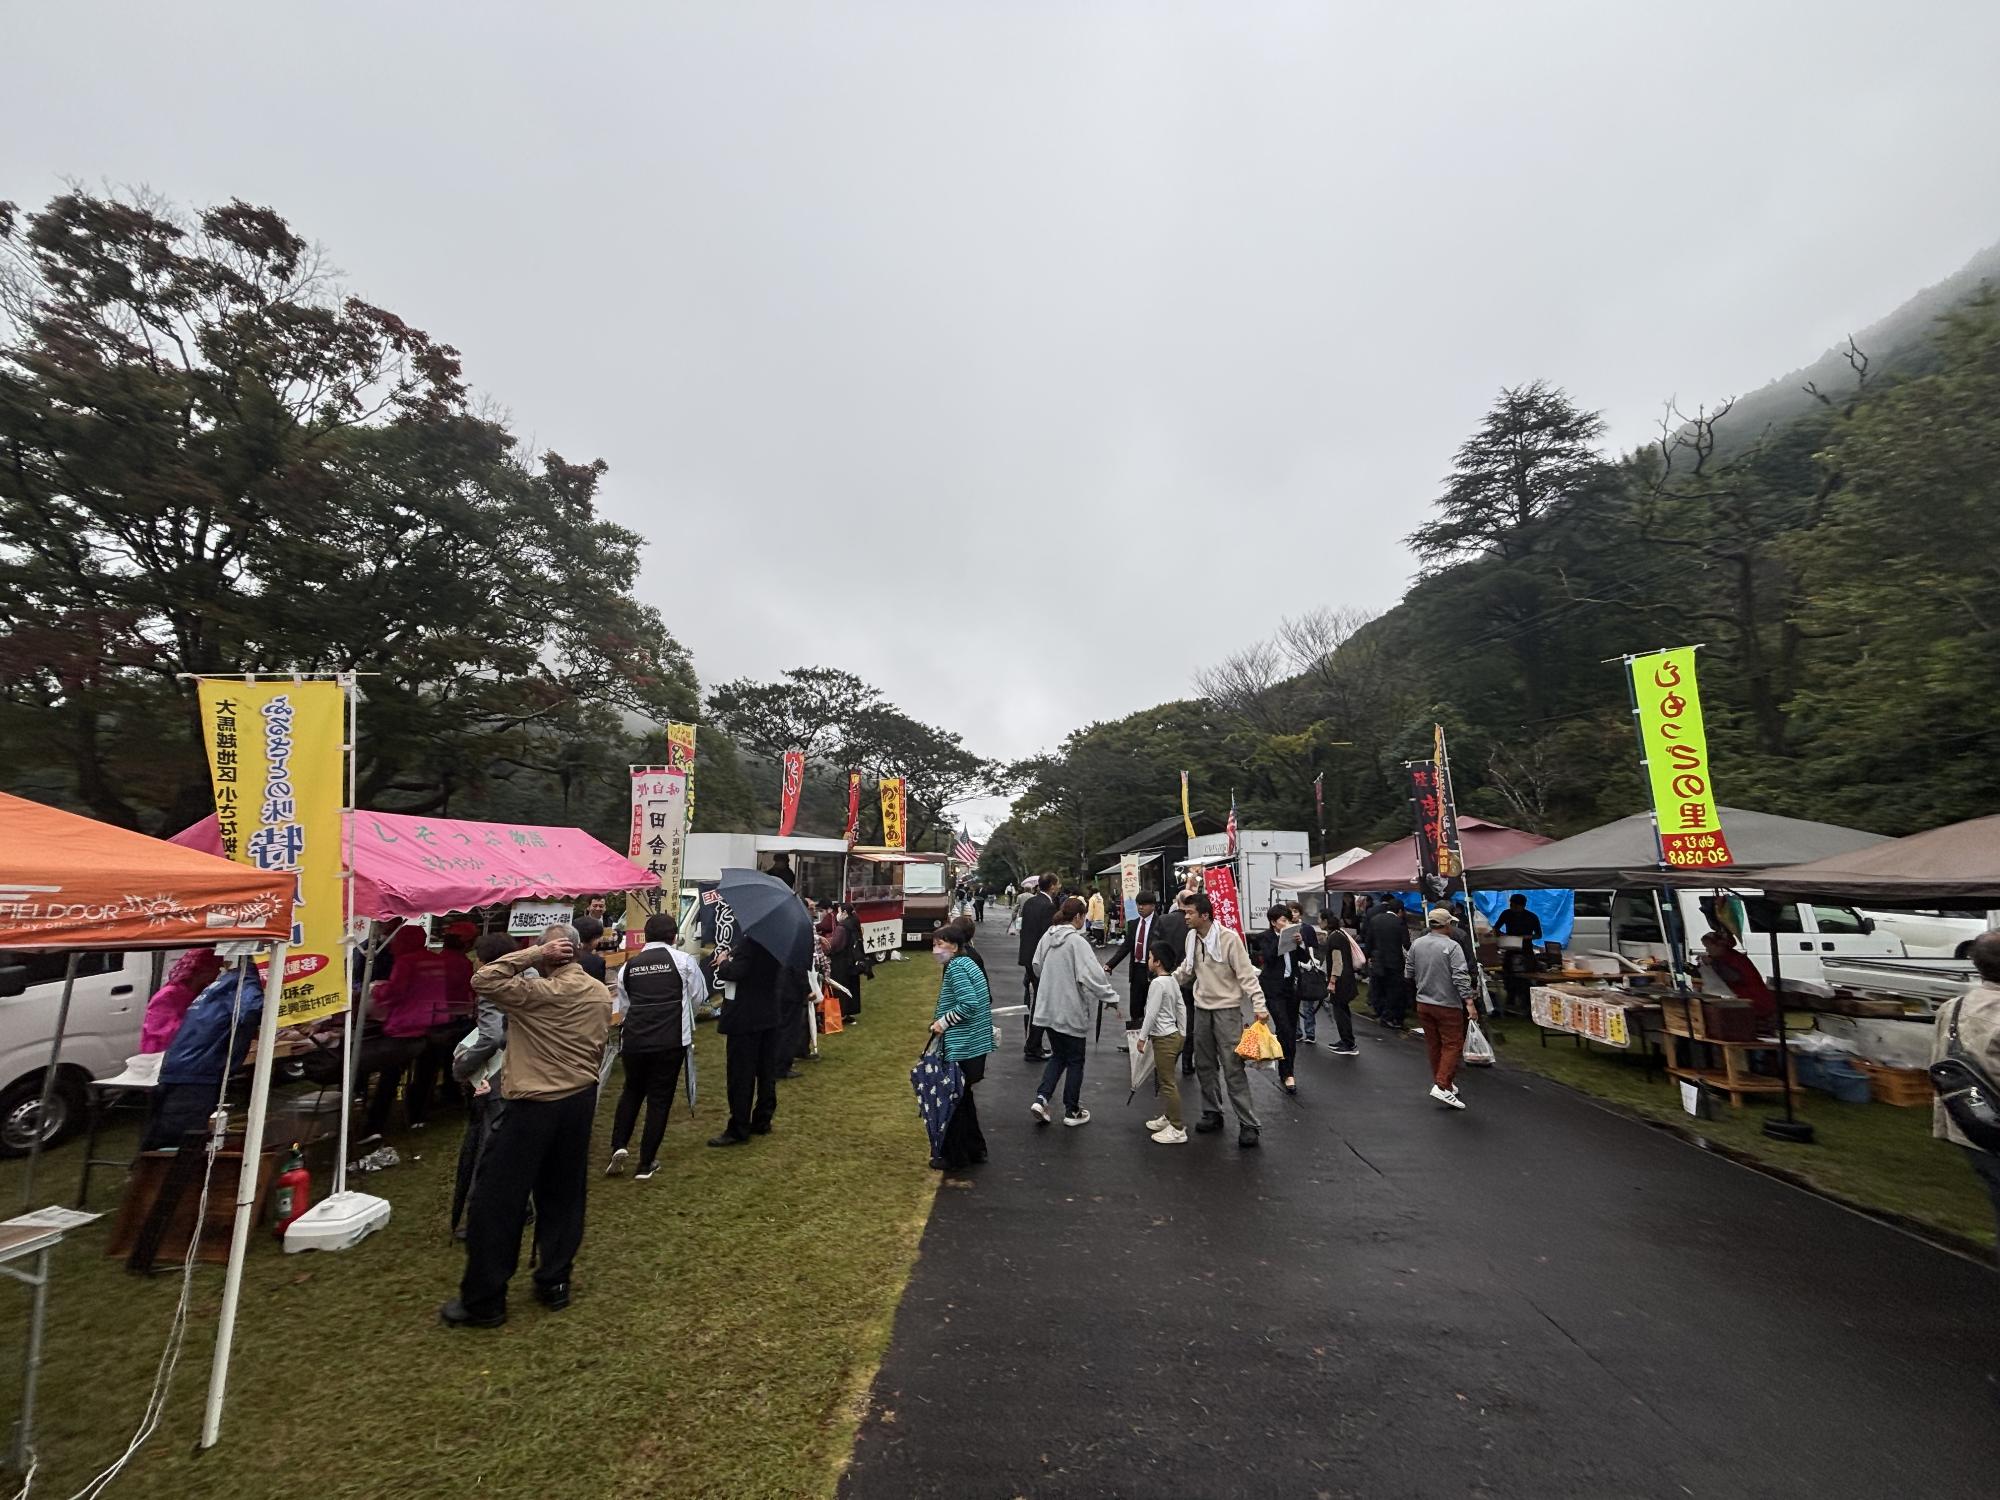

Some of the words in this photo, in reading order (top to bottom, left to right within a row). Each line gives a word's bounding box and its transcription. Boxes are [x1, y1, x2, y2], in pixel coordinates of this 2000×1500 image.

[881, 784, 902, 846] からあ
[0, 903, 120, 918] FIELDOOR
